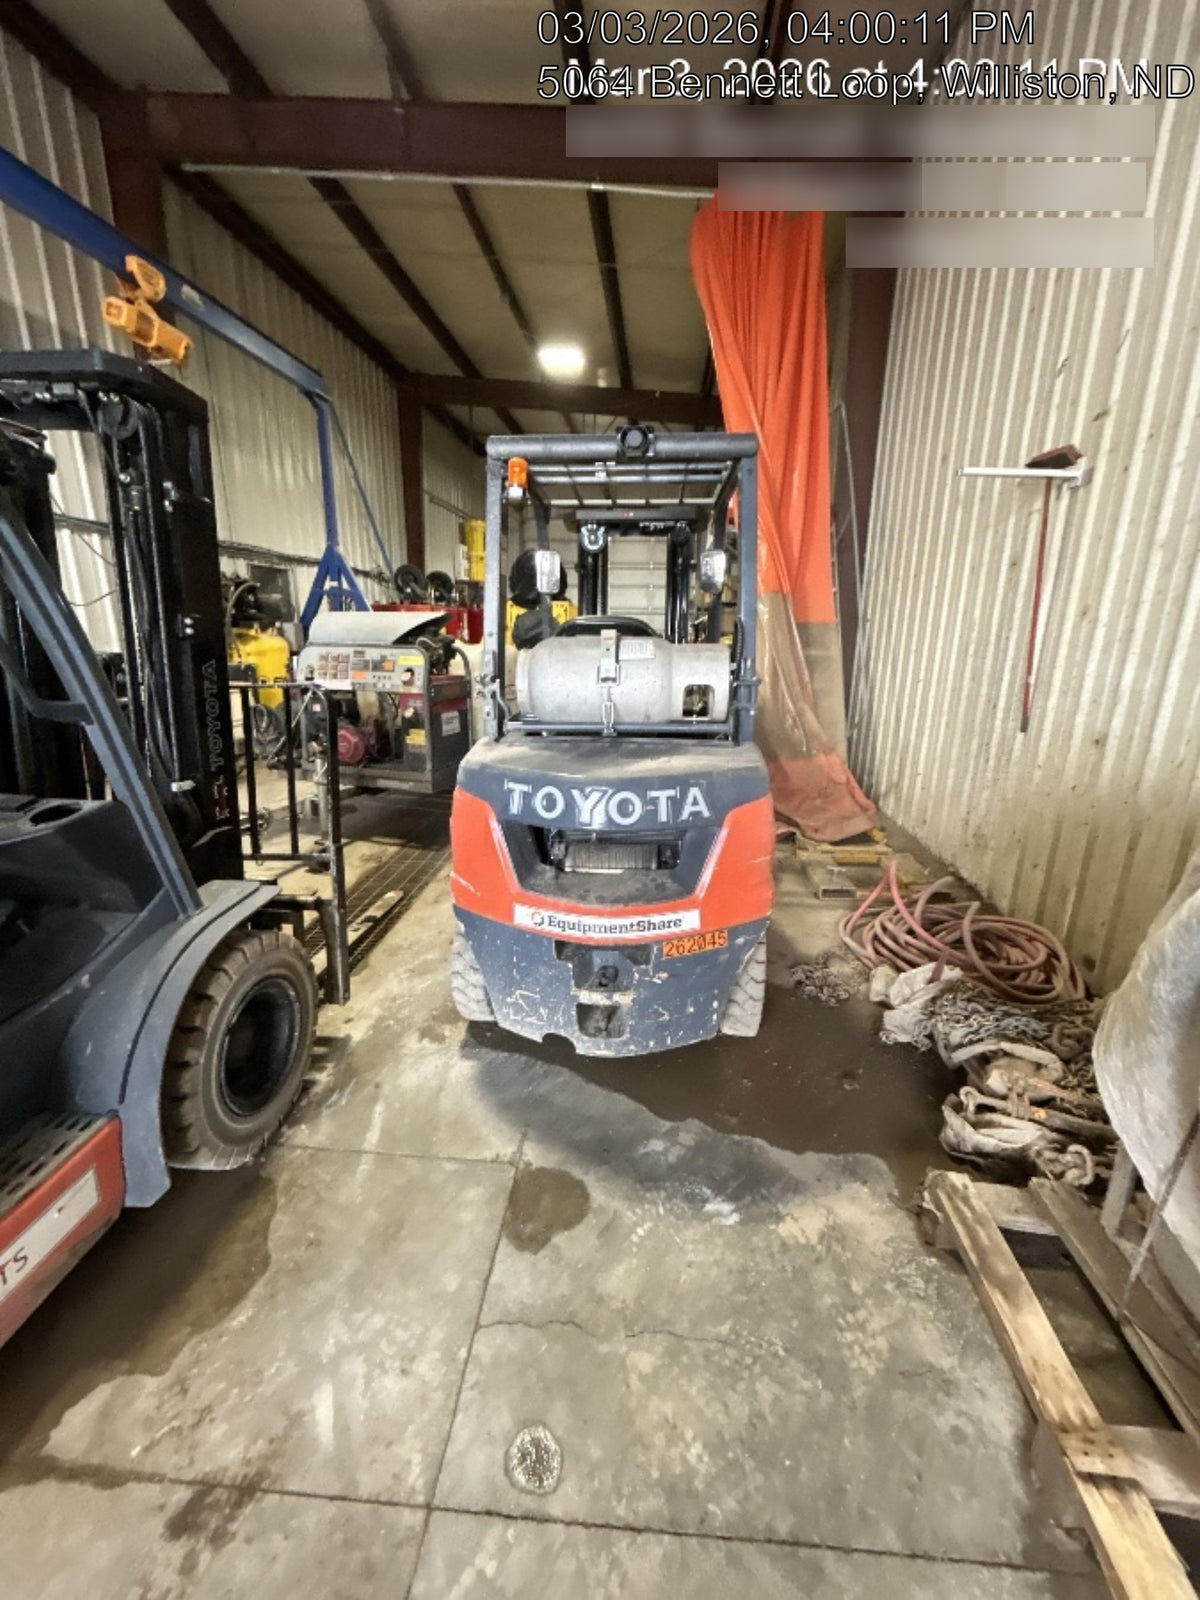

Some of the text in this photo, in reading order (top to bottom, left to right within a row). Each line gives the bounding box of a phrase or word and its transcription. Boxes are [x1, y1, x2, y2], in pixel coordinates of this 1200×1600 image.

[202, 659, 224, 772] TOYOTA
[504, 780, 711, 828] TOYOTA
[547, 914, 683, 935] EquipmentShare
